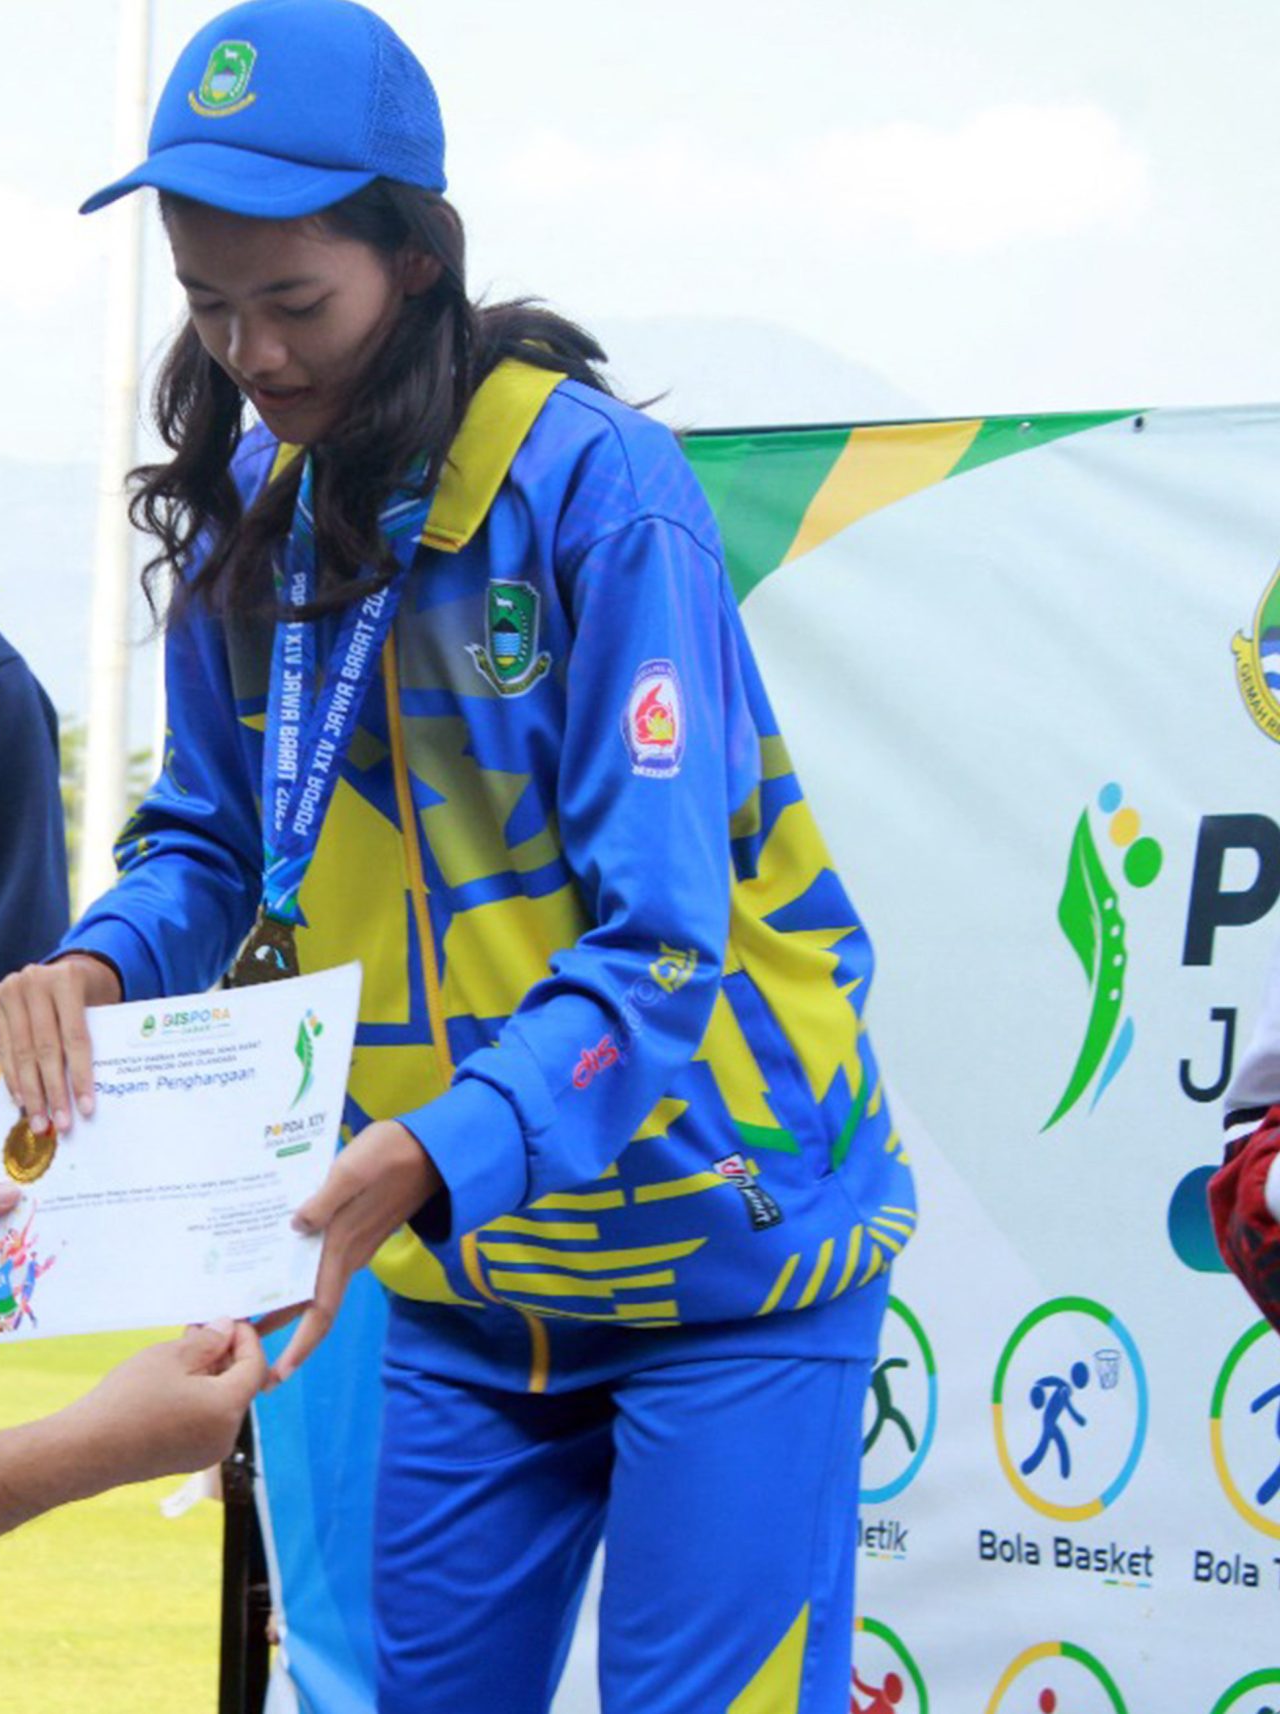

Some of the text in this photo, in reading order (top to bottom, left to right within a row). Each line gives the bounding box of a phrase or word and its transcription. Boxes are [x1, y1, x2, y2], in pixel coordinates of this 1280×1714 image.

[284, 633, 302, 665] XIV
[341, 618, 376, 681] BARAT
[280, 669, 303, 722] JAWA
[323, 681, 355, 738] JAWA
[277, 725, 299, 784] BARAT
[312, 738, 336, 774] XIV
[292, 775, 326, 836] POPDA
[857, 1521, 909, 1553] letik
[978, 1529, 1155, 1579] Bola Basket
[1192, 1549, 1260, 1588] Bola
